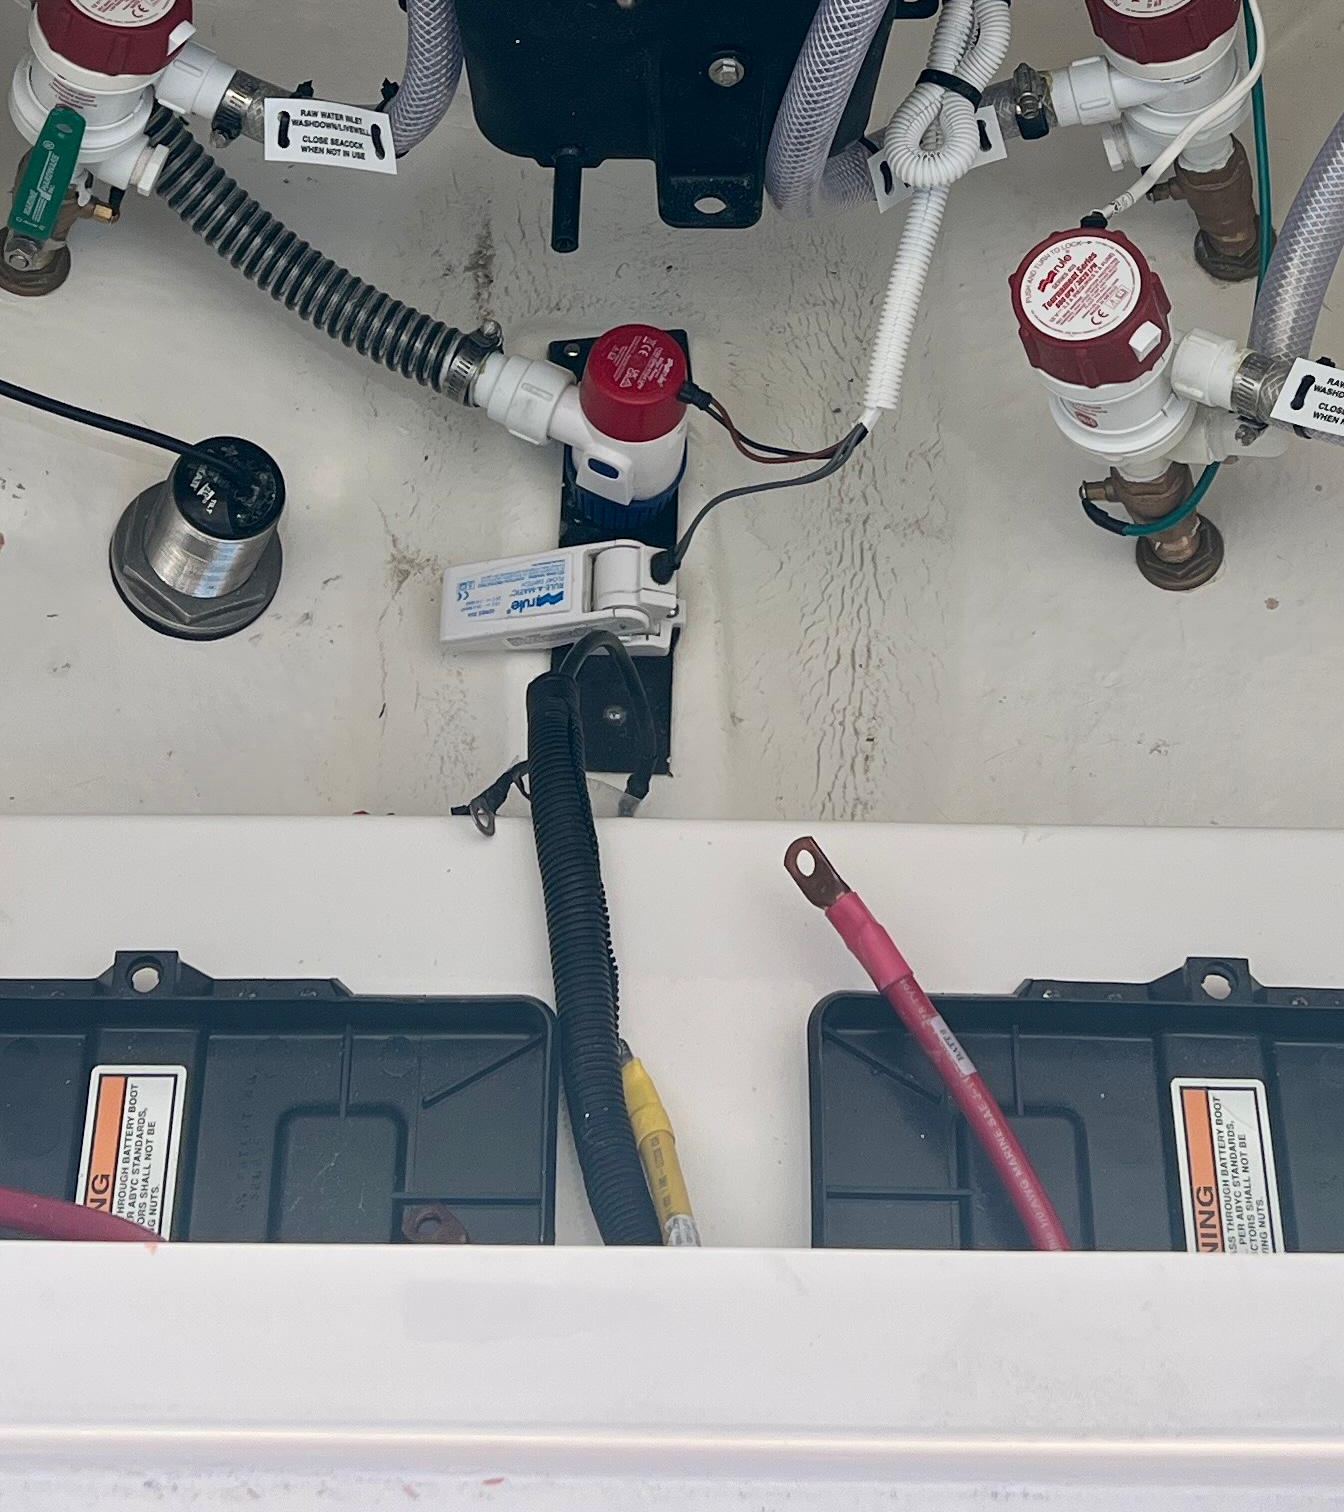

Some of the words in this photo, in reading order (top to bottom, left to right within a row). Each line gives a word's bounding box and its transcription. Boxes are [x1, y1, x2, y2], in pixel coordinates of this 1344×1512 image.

[291, 119, 371, 137] WASHDOWN/LIVEWELL
[300, 109, 318, 117] RAW
[321, 111, 344, 120] WATER
[345, 115, 362, 124] INLET
[301, 145, 325, 154] WHEN
[326, 147, 341, 157] NOT
[343, 149, 350, 157] IN
[351, 151, 366, 160] USE
[302, 135, 329, 145] CLOSE
[330, 137, 363, 149] SEACOCK
[1041, 271, 1080, 311] Tournament
[1077, 251, 1097, 274] Series
[1312, 411, 1339, 424] WHEN
[128, 1083, 139, 1113] BOOT
[1213, 1096, 1224, 1126] BOOT
[147, 1121, 156, 1137] BE
[978, 1104, 998, 1128] SAE
[122, 1116, 135, 1165] BATTERY
[145, 1138, 154, 1160] NOT
[993, 1127, 1022, 1178] MARINE
[1217, 1130, 1229, 1178] BATTERY
[1239, 1134, 1247, 1149] BE
[1241, 1152, 1250, 1174] NOT
[117, 1167, 130, 1214] HROUGH
[128, 1175, 139, 1208] ABYC
[140, 1164, 151, 1199] SHALL
[1019, 1178, 1041, 1210] AWG
[1245, 1178, 1255, 1214] SHALL
[136, 1202, 147, 1225] ORS
[1224, 1179, 1234, 1235] THROUGH
[1233, 1190, 1246, 1222] ABYC
[1239, 1225, 1247, 1245] PER
[1248, 1215, 1258, 1254] CTORS
